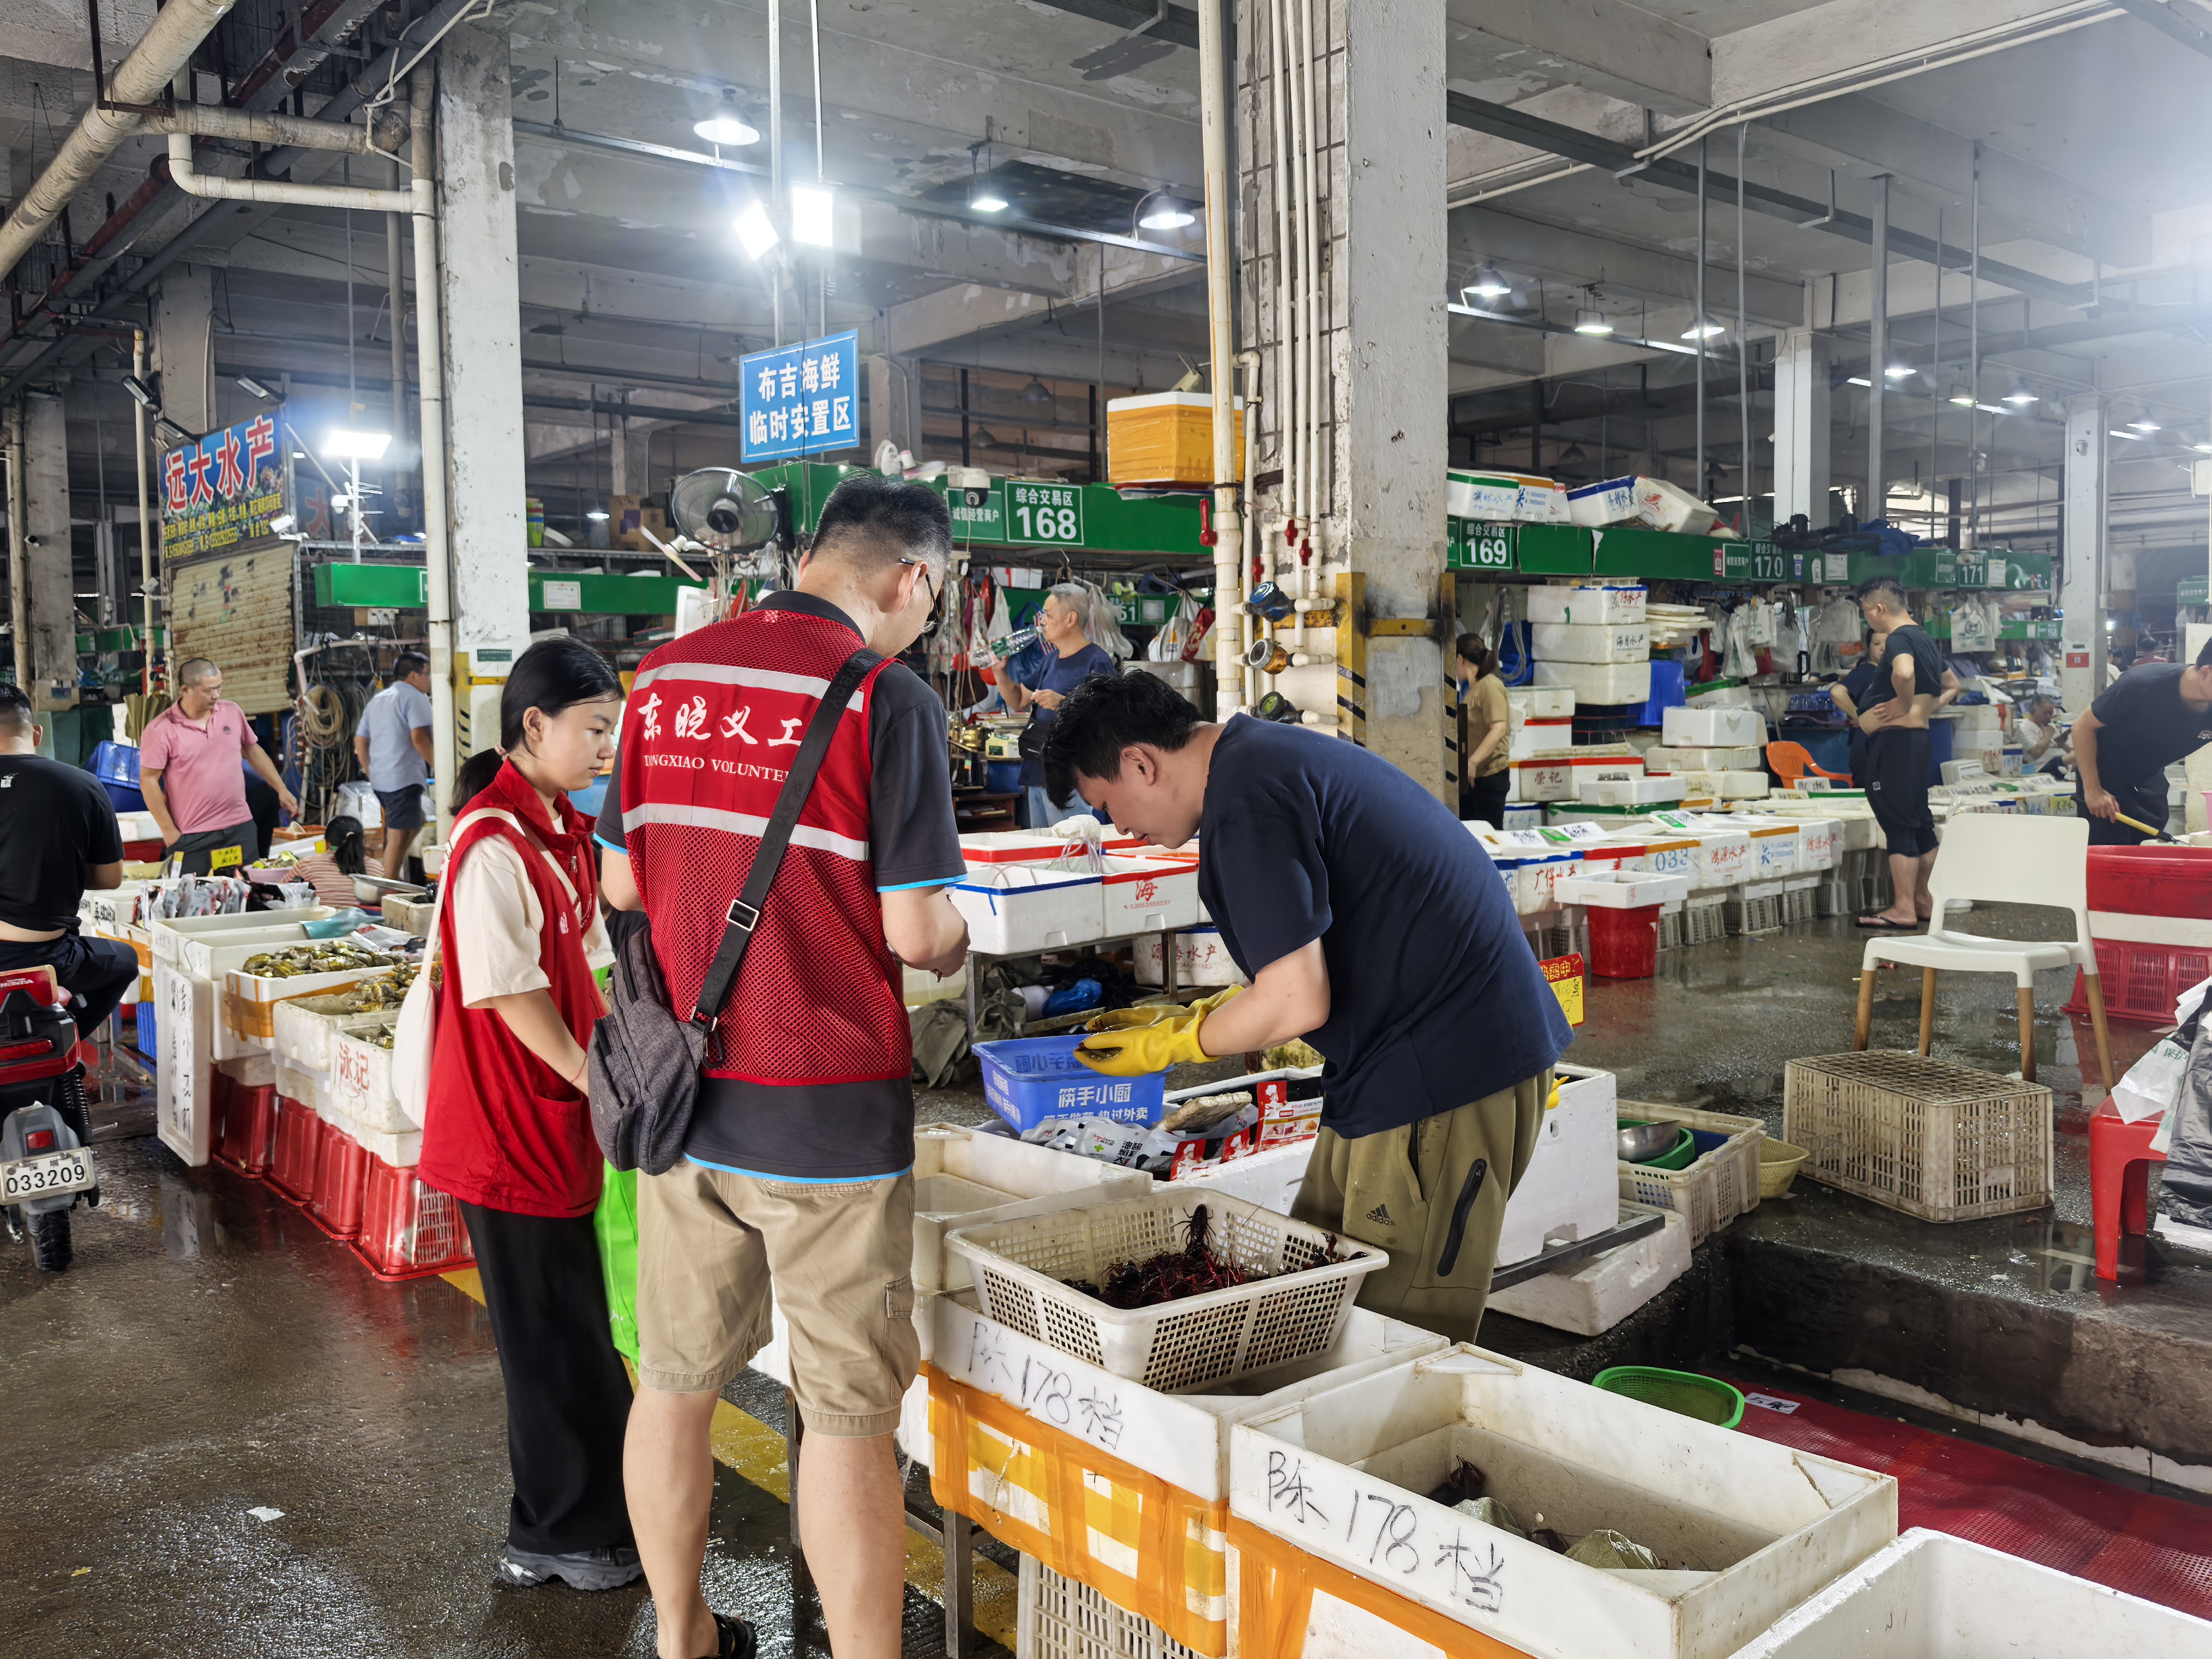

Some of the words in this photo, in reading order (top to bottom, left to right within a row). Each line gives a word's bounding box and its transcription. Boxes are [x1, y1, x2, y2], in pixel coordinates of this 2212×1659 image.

[758, 352, 841, 403] 布吉海鲜
[749, 396, 852, 444] 临时安置区
[165, 414, 274, 513] 远大水产
[1016, 488, 1074, 507] 综合交易区
[953, 507, 999, 523] 诚信经营商户
[1016, 507, 1077, 539] 168
[1467, 523, 1506, 537] 综合交易区
[1467, 537, 1507, 565] 169
[1755, 556, 1783, 578] 170
[1962, 565, 1984, 584] 171
[637, 692, 804, 747] 东晓义工
[711, 758, 789, 783] VOLUNTE
[1135, 880, 1158, 902] 海
[1058, 1083, 1133, 1108] 筷手小厨
[29, 1159, 59, 1171] 深圳
[6, 1165, 85, 1193] 033209
[1366, 1212, 1396, 1226] adidas
[1267, 1450, 1505, 1614] 陈178档
